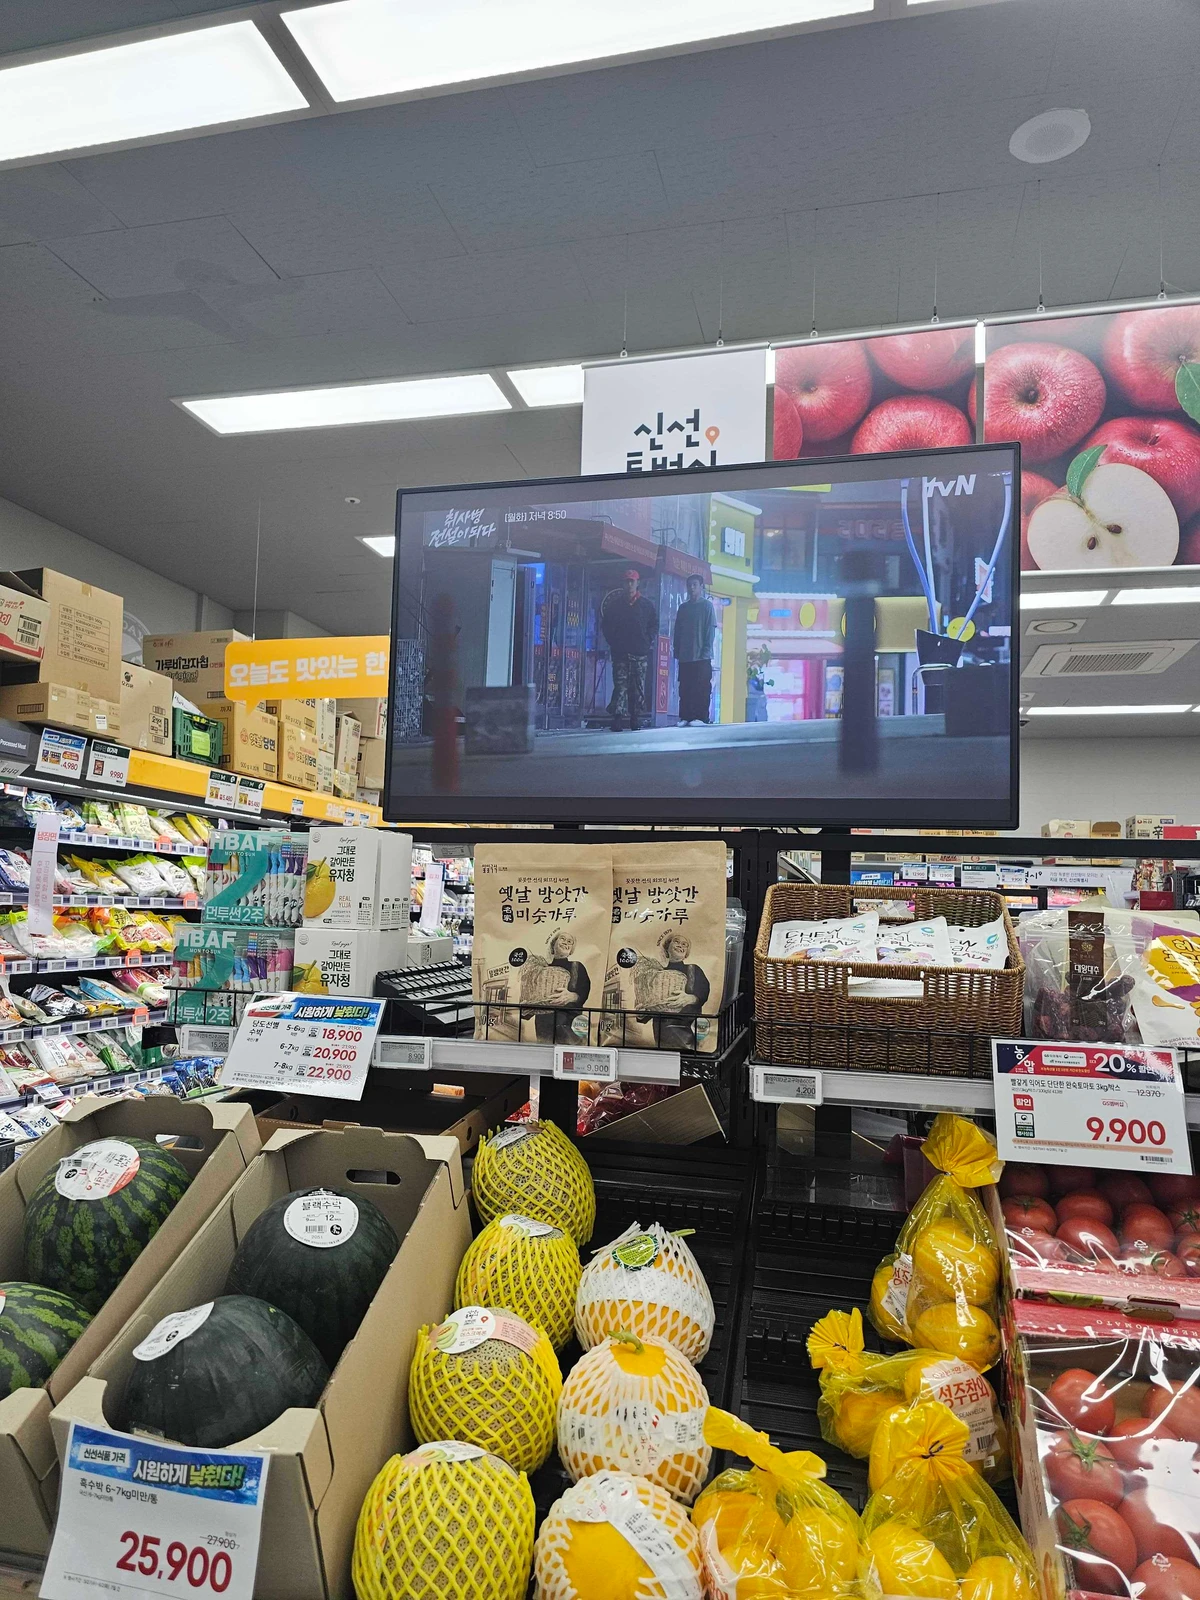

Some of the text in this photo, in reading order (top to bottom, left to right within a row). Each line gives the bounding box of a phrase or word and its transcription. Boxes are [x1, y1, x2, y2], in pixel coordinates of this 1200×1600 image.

[633, 408, 700, 451] 신선
[926, 474, 977, 498] tvN
[444, 508, 485, 528] 취사병
[504, 509, 567, 522] [월화] 저녁 8:50
[155, 655, 209, 672] 가루비감자칩
[230, 650, 387, 688] 오늘도 맛있는 한
[1152, 825, 1163, 839] 辛
[209, 834, 270, 851] HBAF
[336, 845, 356, 856] 그대로
[329, 857, 356, 868] 갈아만든
[328, 869, 355, 883] 유자청
[498, 885, 589, 904] 옛날 방앗간
[648, 886, 699, 904] 방앗간
[206, 905, 263, 923] 먼투썬2주
[516, 907, 577, 925] 미숫가루
[624, 908, 689, 925] 미숫가루
[175, 930, 237, 950] HBAF
[328, 950, 351, 960] 그대로
[320, 961, 351, 972] 갈아만든
[319, 973, 350, 988] 유자청
[294, 1005, 334, 1019] 시원하게
[334, 1006, 370, 1019] 낮췄다!
[249, 1028, 264, 1037] 수박
[251, 1020, 280, 1031] 당도선별
[286, 1024, 363, 1042] 5-6kg 18,900
[279, 1042, 357, 1062] 6-7kg 20,900
[1014, 1045, 1025, 1060] 농
[273, 1062, 294, 1071] 7-8kg
[306, 1066, 352, 1081] 22,900
[1023, 1060, 1036, 1074] 할
[1093, 1053, 1137, 1074] 20%
[1028, 1079, 1047, 1088] 익어도
[1047, 1080, 1065, 1089] 단단한
[1065, 1081, 1095, 1090] 완숙토마토
[1016, 1098, 1031, 1107] 할인
[1086, 1116, 1166, 1146] 9,900
[302, 1200, 342, 1211] 블랙수박
[938, 1374, 990, 1409] 성주참외
[83, 1449, 246, 1488] 신선식품 가격 시원하게 낮췄다!
[79, 1477, 104, 1493] 흑수박
[116, 1530, 233, 1593] 25,900
